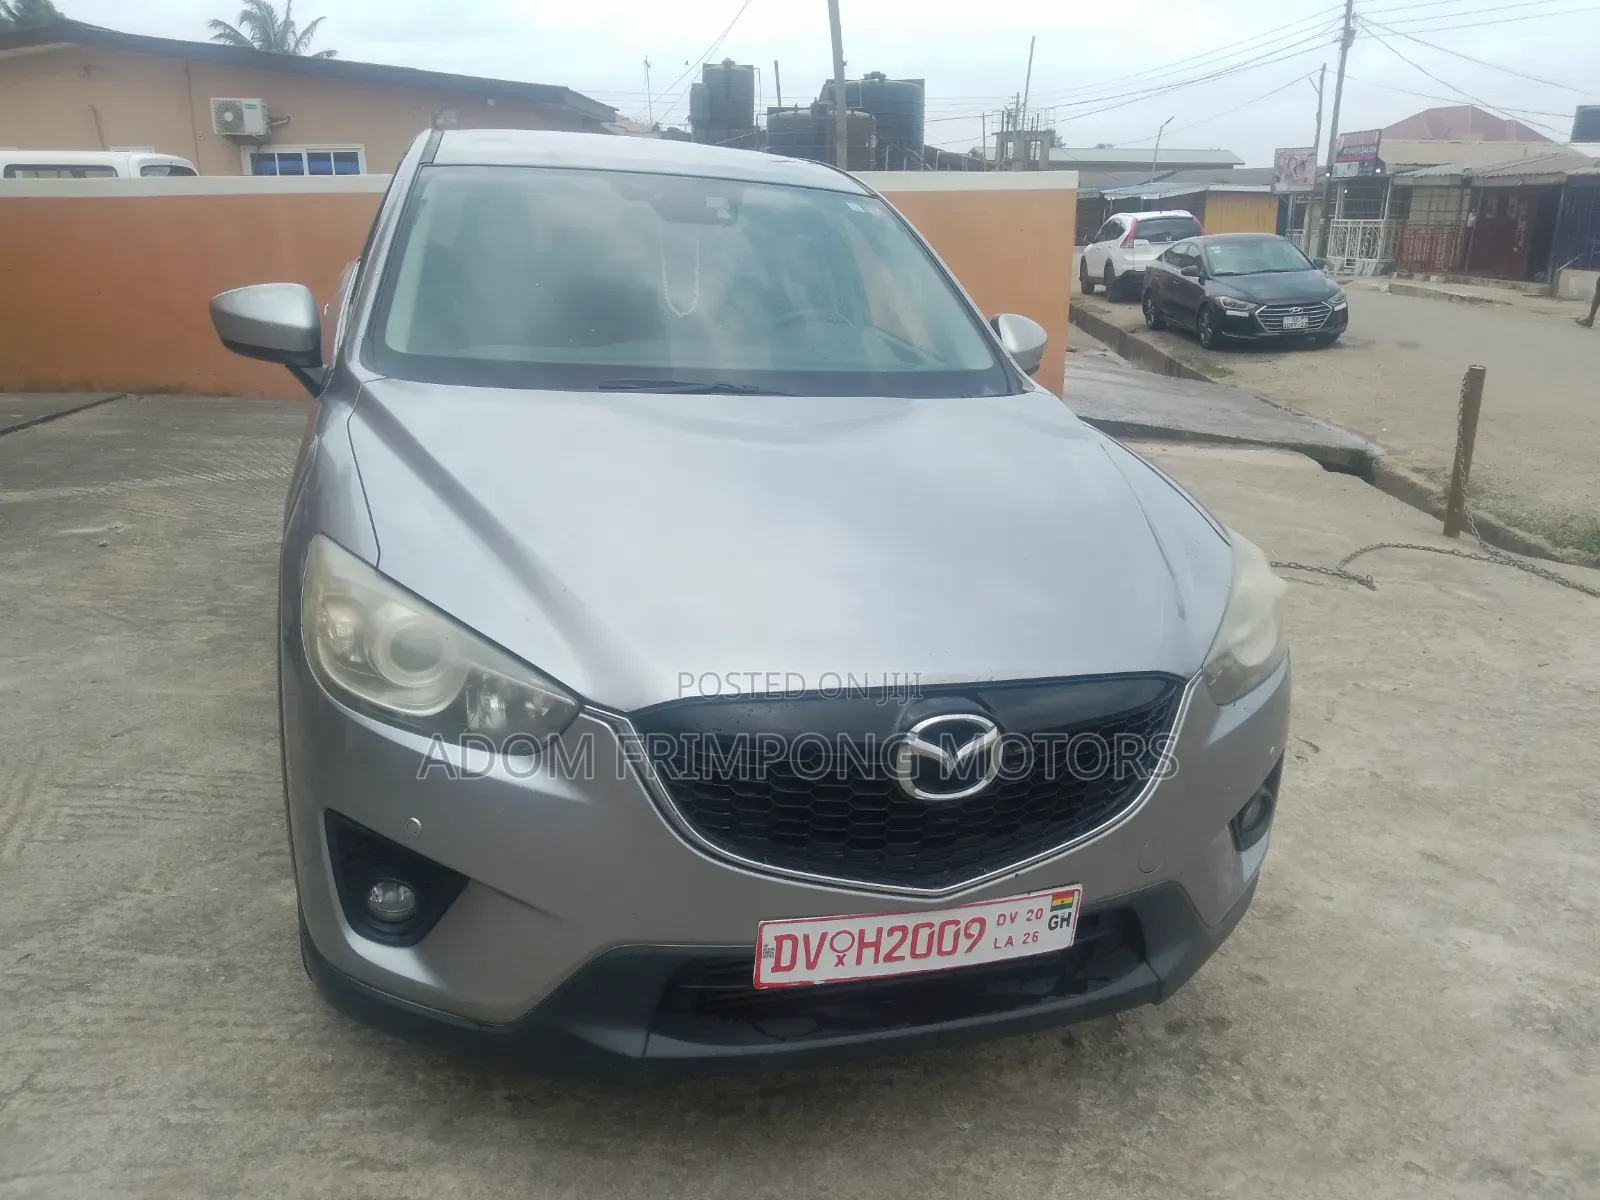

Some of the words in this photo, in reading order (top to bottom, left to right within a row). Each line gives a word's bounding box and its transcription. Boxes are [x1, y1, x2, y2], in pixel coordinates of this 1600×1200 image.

[996, 911, 1018, 927] DV
[1026, 907, 1044, 922] 20
[1047, 911, 1072, 931] GH
[993, 935, 1014, 949] LA
[1022, 930, 1040, 945] 26
